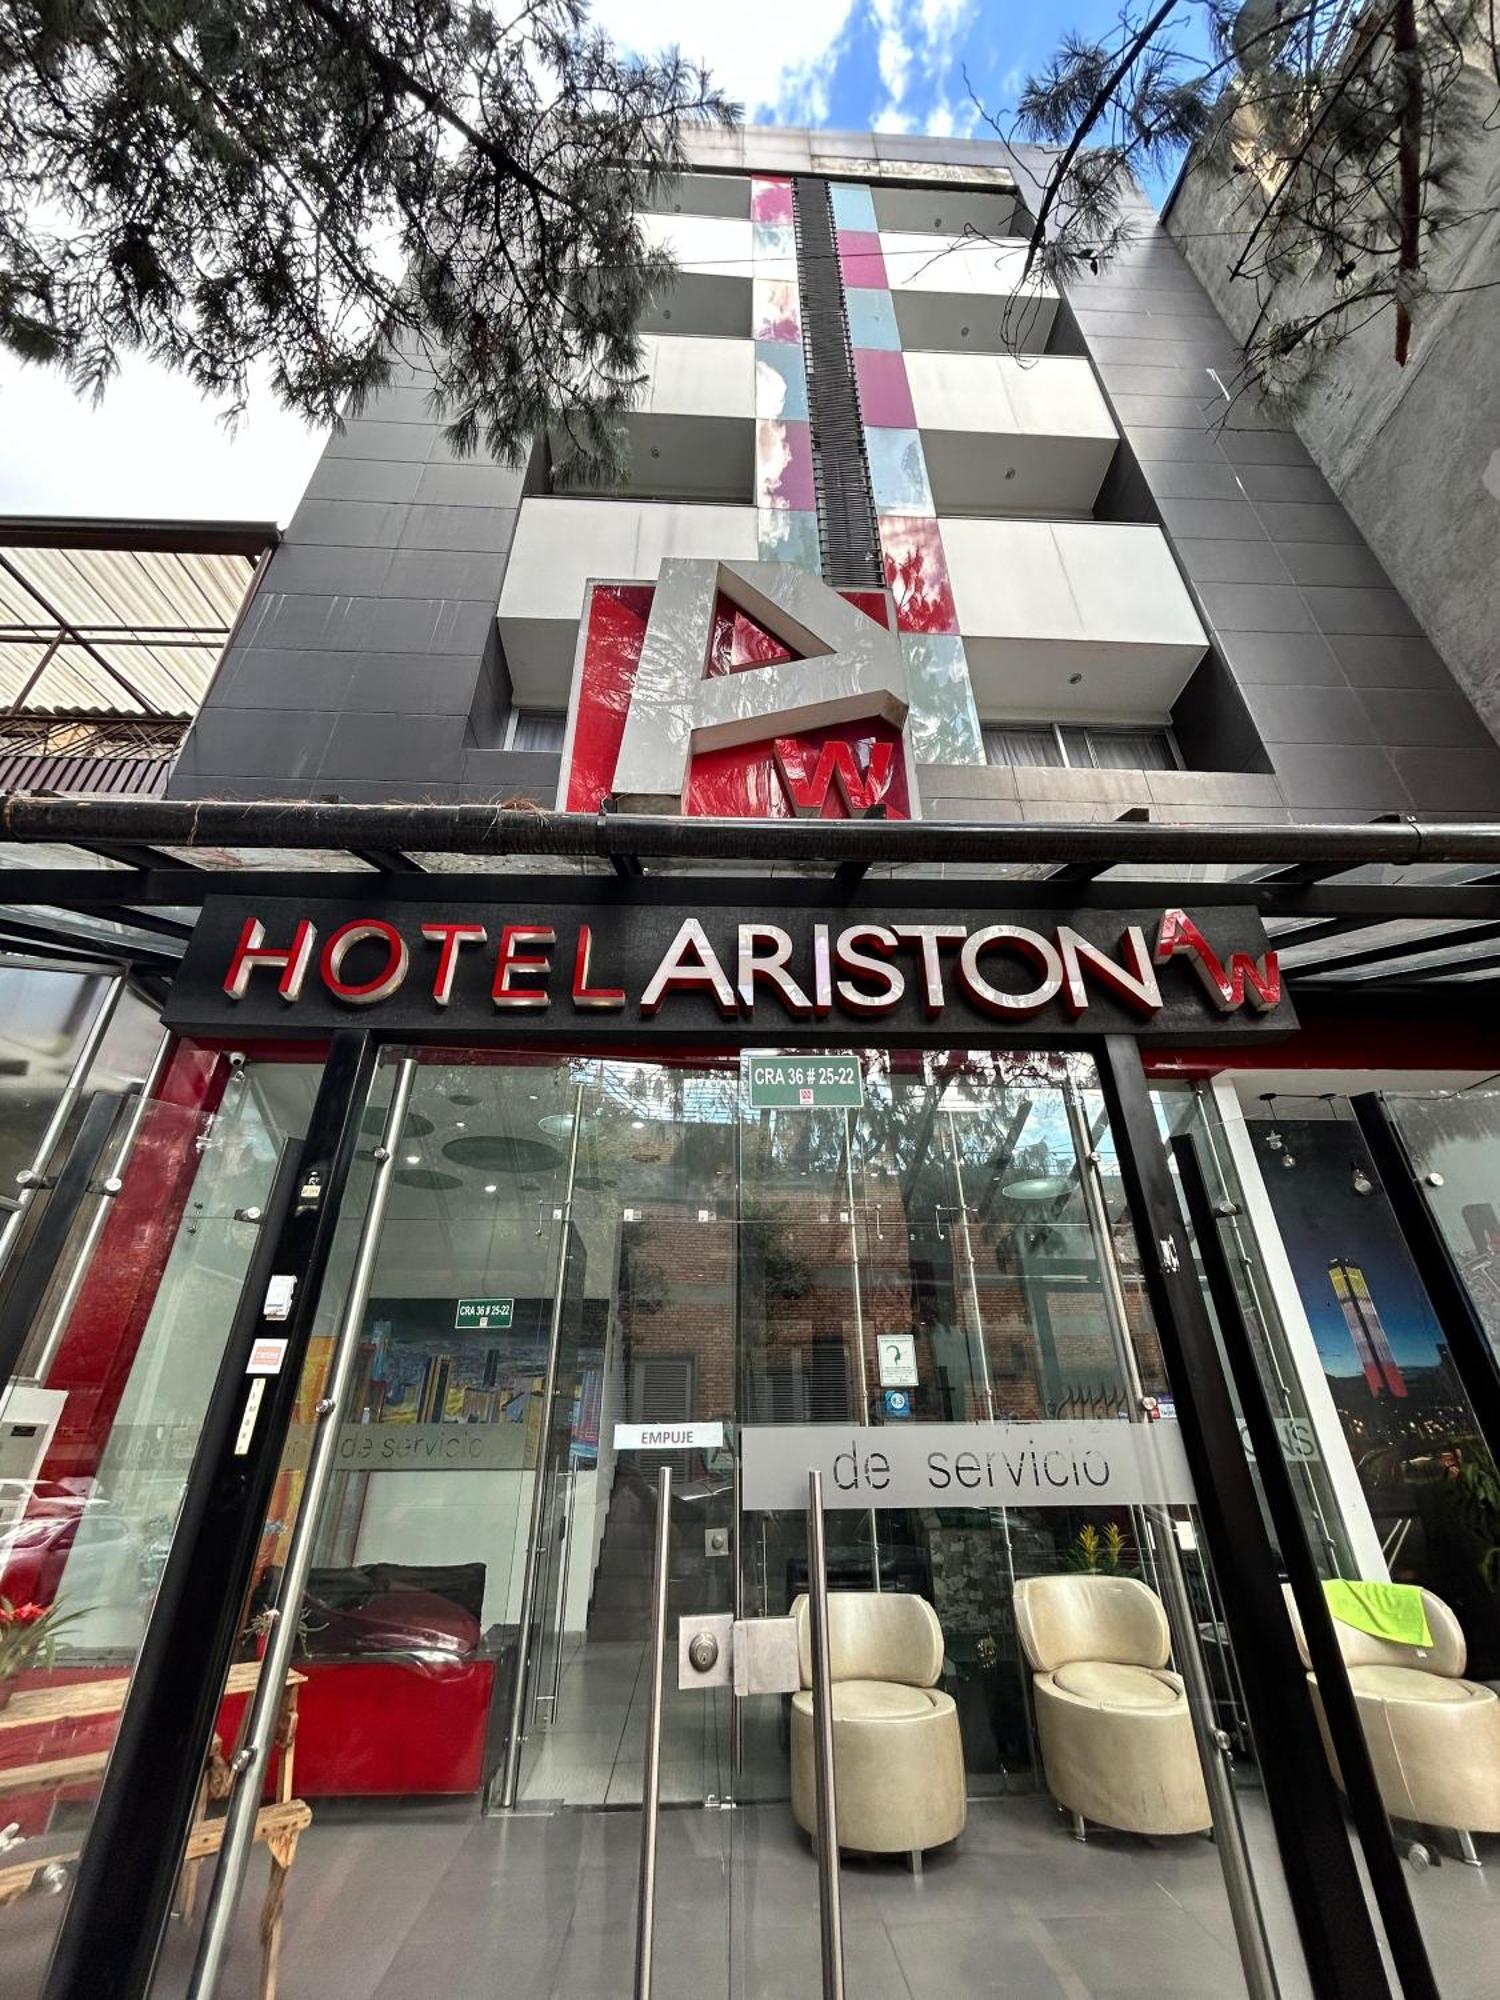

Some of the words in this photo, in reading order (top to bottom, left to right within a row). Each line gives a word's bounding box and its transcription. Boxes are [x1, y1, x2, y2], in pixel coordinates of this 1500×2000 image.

[222, 916, 627, 1008] HOTEL
[640, 917, 1164, 1017] ARISTON
[754, 1067, 785, 1085] CRA
[788, 1068, 804, 1085] 36
[806, 1068, 816, 1084] #
[818, 1067, 855, 1085] 25-22
[459, 1305, 475, 1316] CRA
[340, 1431, 374, 1459] de
[381, 1431, 484, 1459] servicio
[640, 1429, 695, 1446] EMPUJE
[832, 1440, 891, 1491] de
[927, 1439, 1111, 1490] servicio
